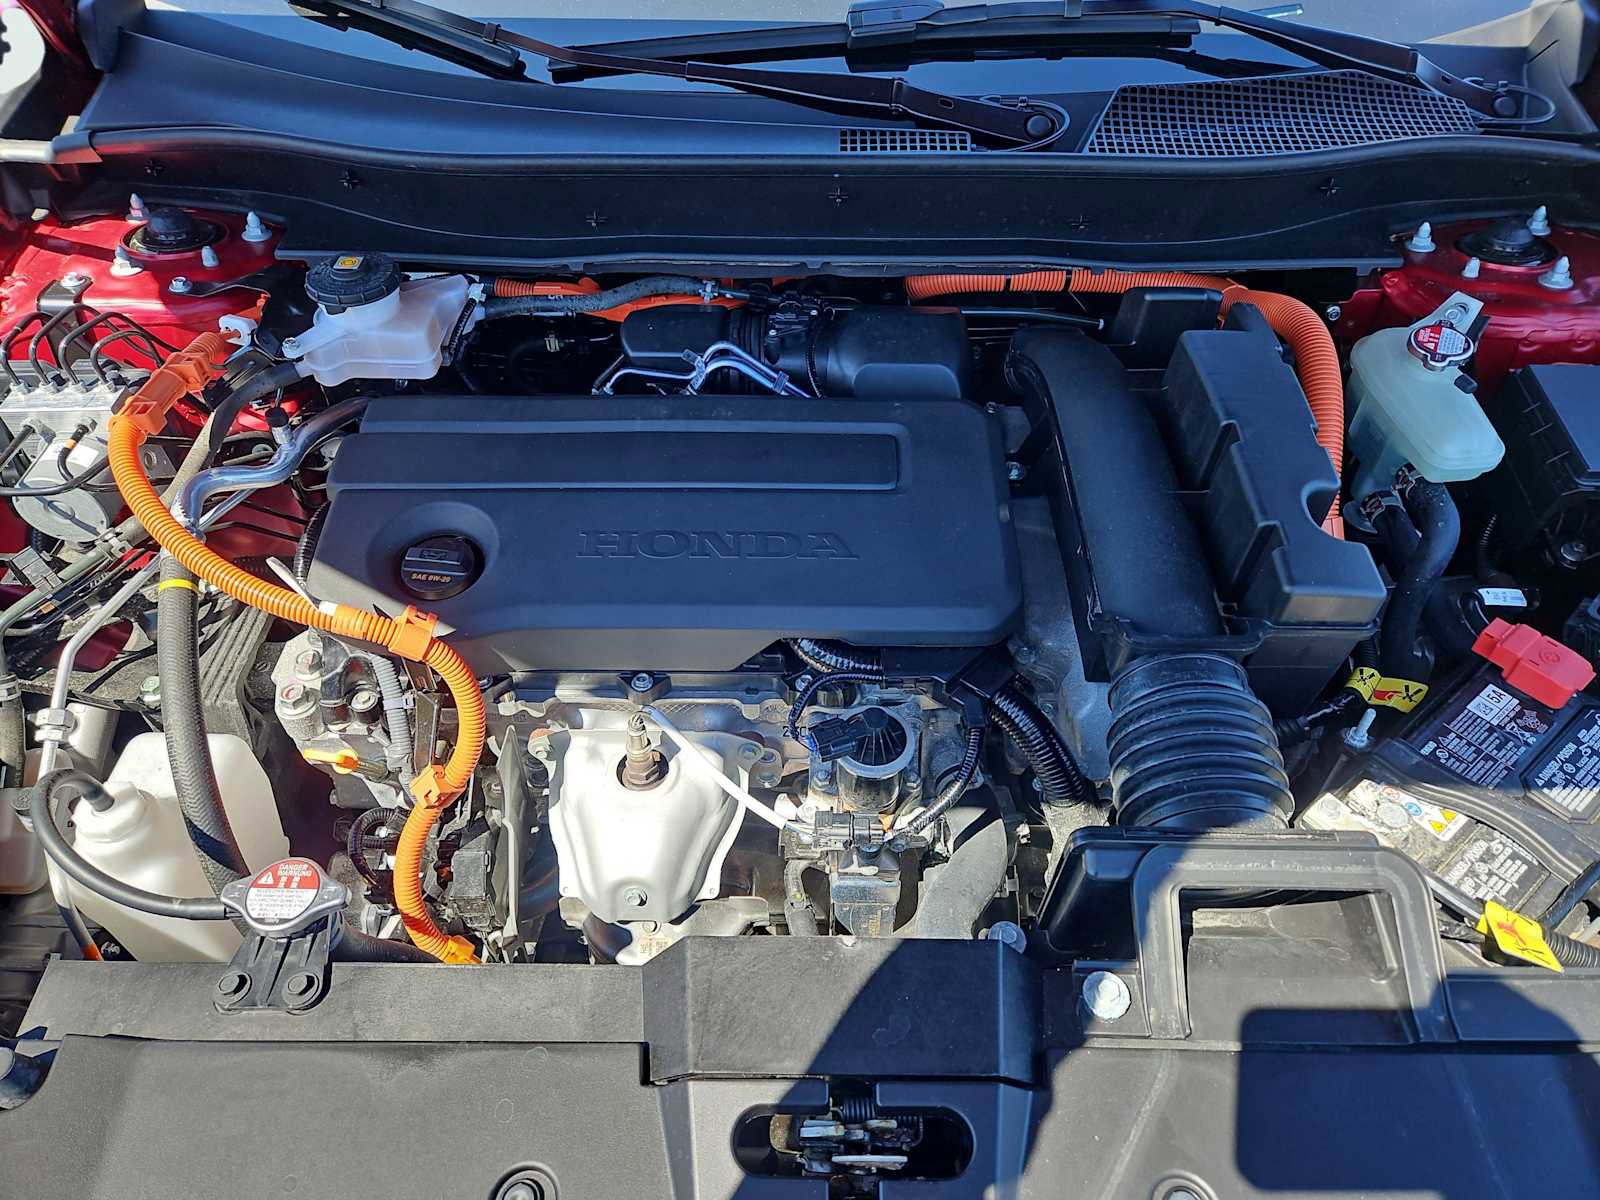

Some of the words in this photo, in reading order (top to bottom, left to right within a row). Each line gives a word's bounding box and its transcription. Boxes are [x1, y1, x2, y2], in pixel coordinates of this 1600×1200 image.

[576, 530, 859, 560] HONDA
[411, 573, 427, 581] SAE
[1487, 690, 1506, 704] 5A
